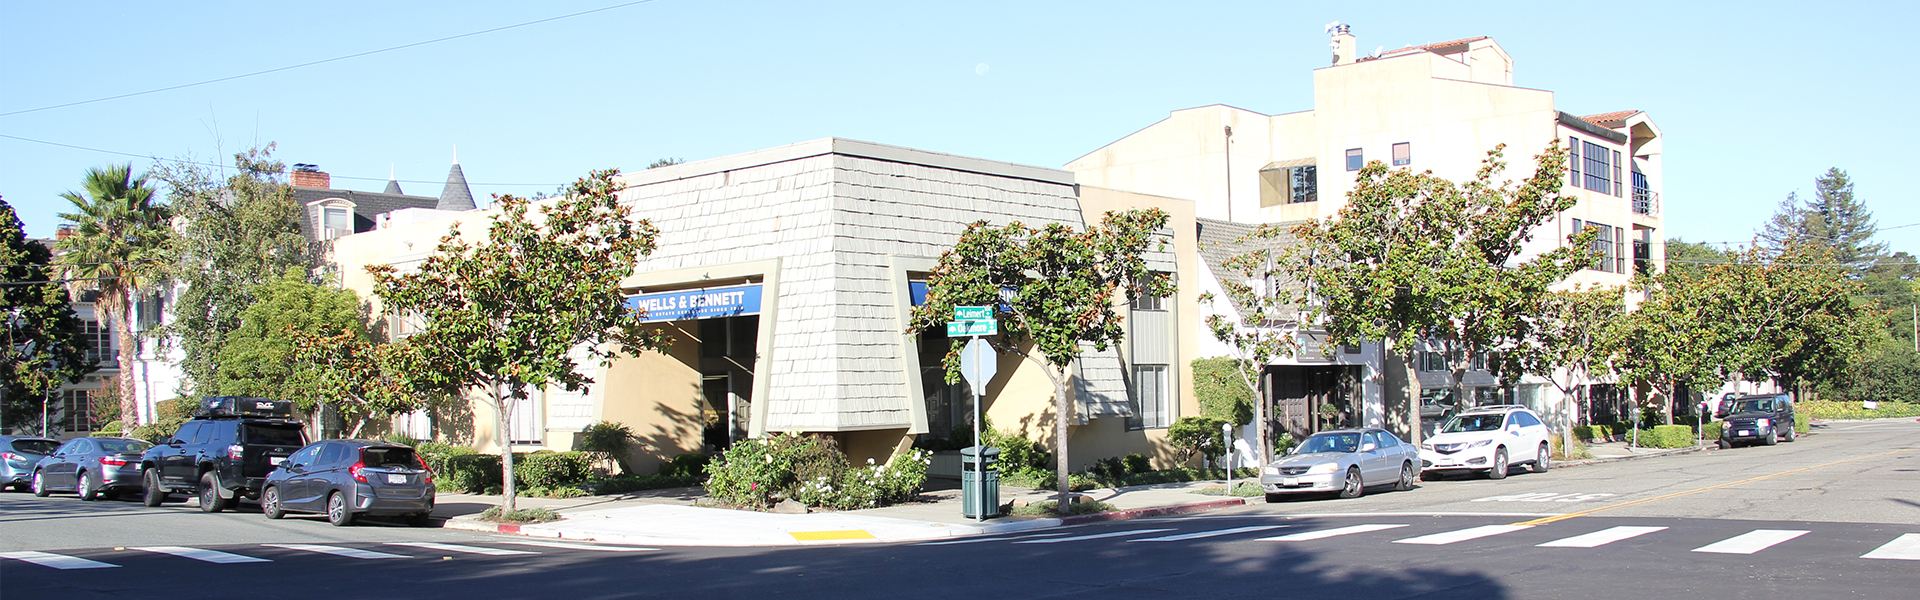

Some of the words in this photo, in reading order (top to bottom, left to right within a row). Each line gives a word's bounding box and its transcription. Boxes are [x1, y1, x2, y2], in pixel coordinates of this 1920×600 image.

[638, 297, 676, 311] WELLS
[678, 295, 687, 309] &
[690, 291, 744, 308] BENNETT
[962, 309, 985, 318] Leimert
[957, 323, 987, 333] Oakmore
